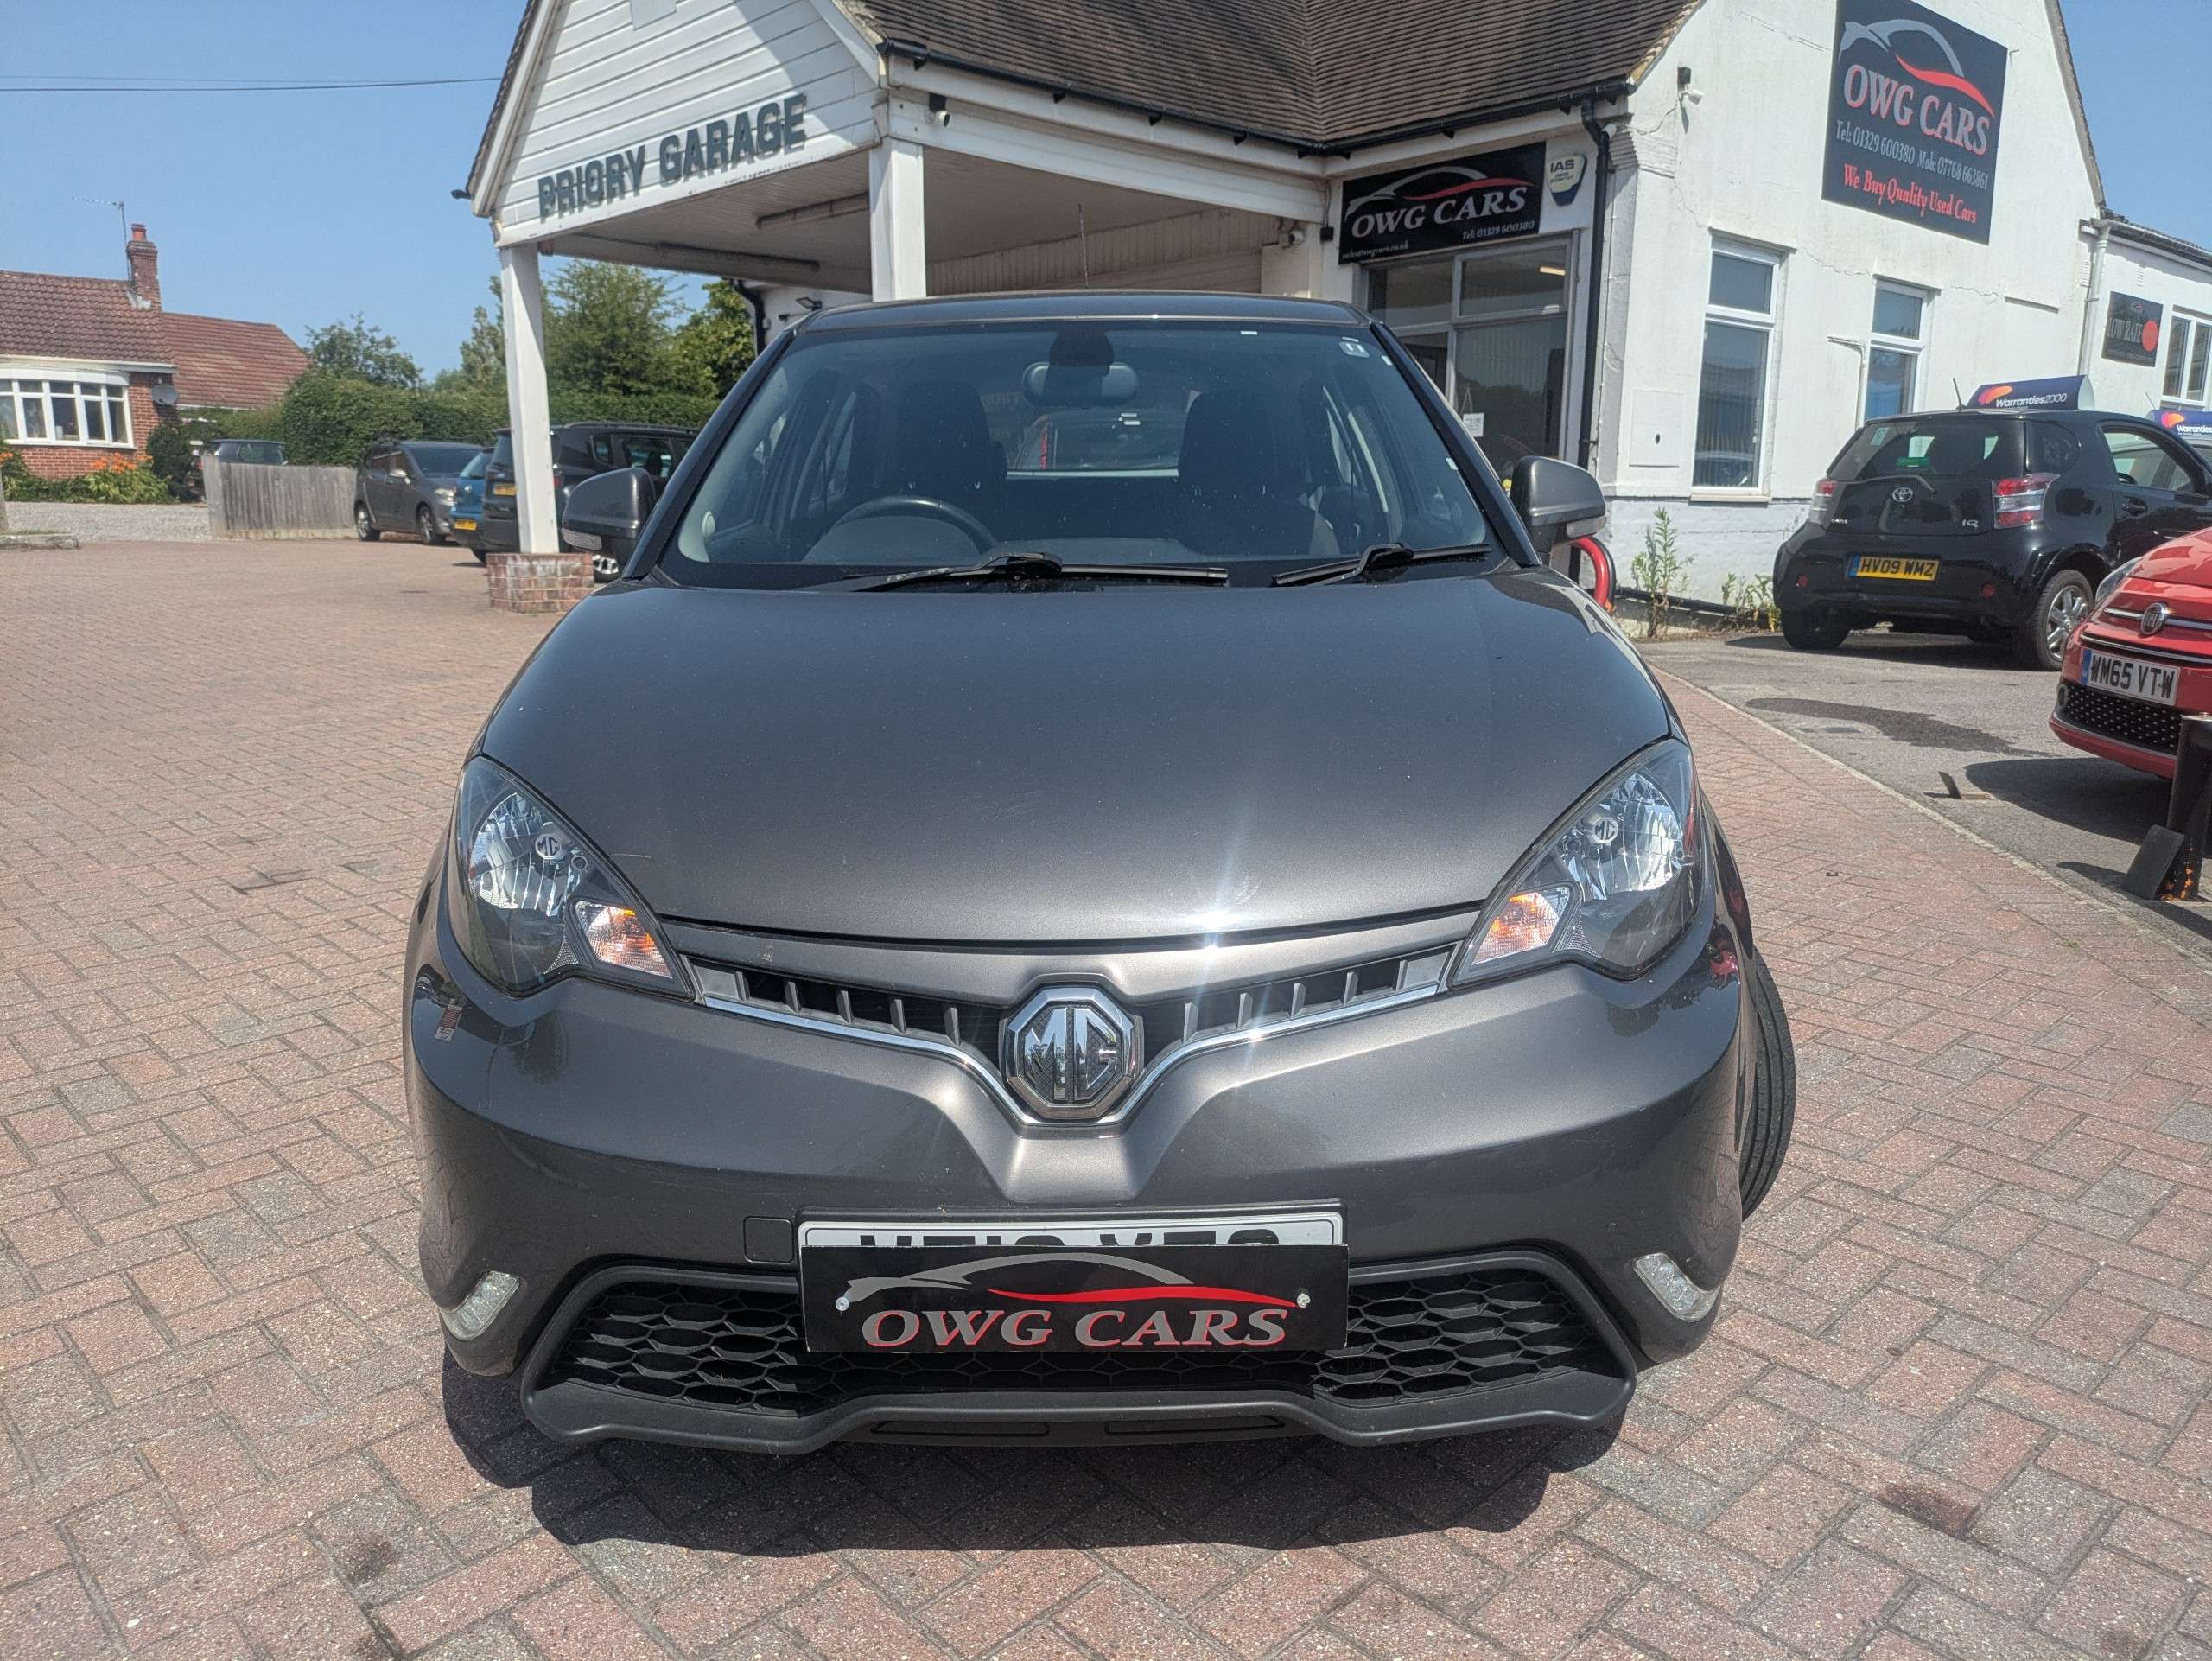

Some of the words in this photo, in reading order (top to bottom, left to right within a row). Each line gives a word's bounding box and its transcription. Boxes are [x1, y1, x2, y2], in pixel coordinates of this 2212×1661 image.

[1844, 64, 1914, 126] OWG
[1920, 95, 1990, 156] CARS
[538, 145, 645, 221] PRIORY
[659, 92, 808, 185] GARAGE
[1836, 119, 1852, 143] Tel:
[1853, 126, 1880, 152] 01329
[1880, 137, 1916, 164] 600380
[1550, 159, 1574, 173] IAS
[1351, 205, 1425, 238] OWG
[1434, 187, 1528, 225] CARS
[1844, 163, 1860, 188] We
[1863, 170, 1886, 206] Buy
[1887, 178, 1928, 217] Quality
[1929, 191, 1954, 215] Used
[1955, 199, 1977, 224] Cars
[1860, 557, 1901, 575] HV09
[1904, 560, 1936, 577] WMZ
[2091, 655, 2133, 690] WM65
[2139, 665, 2176, 699] VTW
[1023, 1004, 1120, 1102] MG
[861, 1308, 1054, 1347] OWG
[1074, 1308, 1290, 1347] CARS
